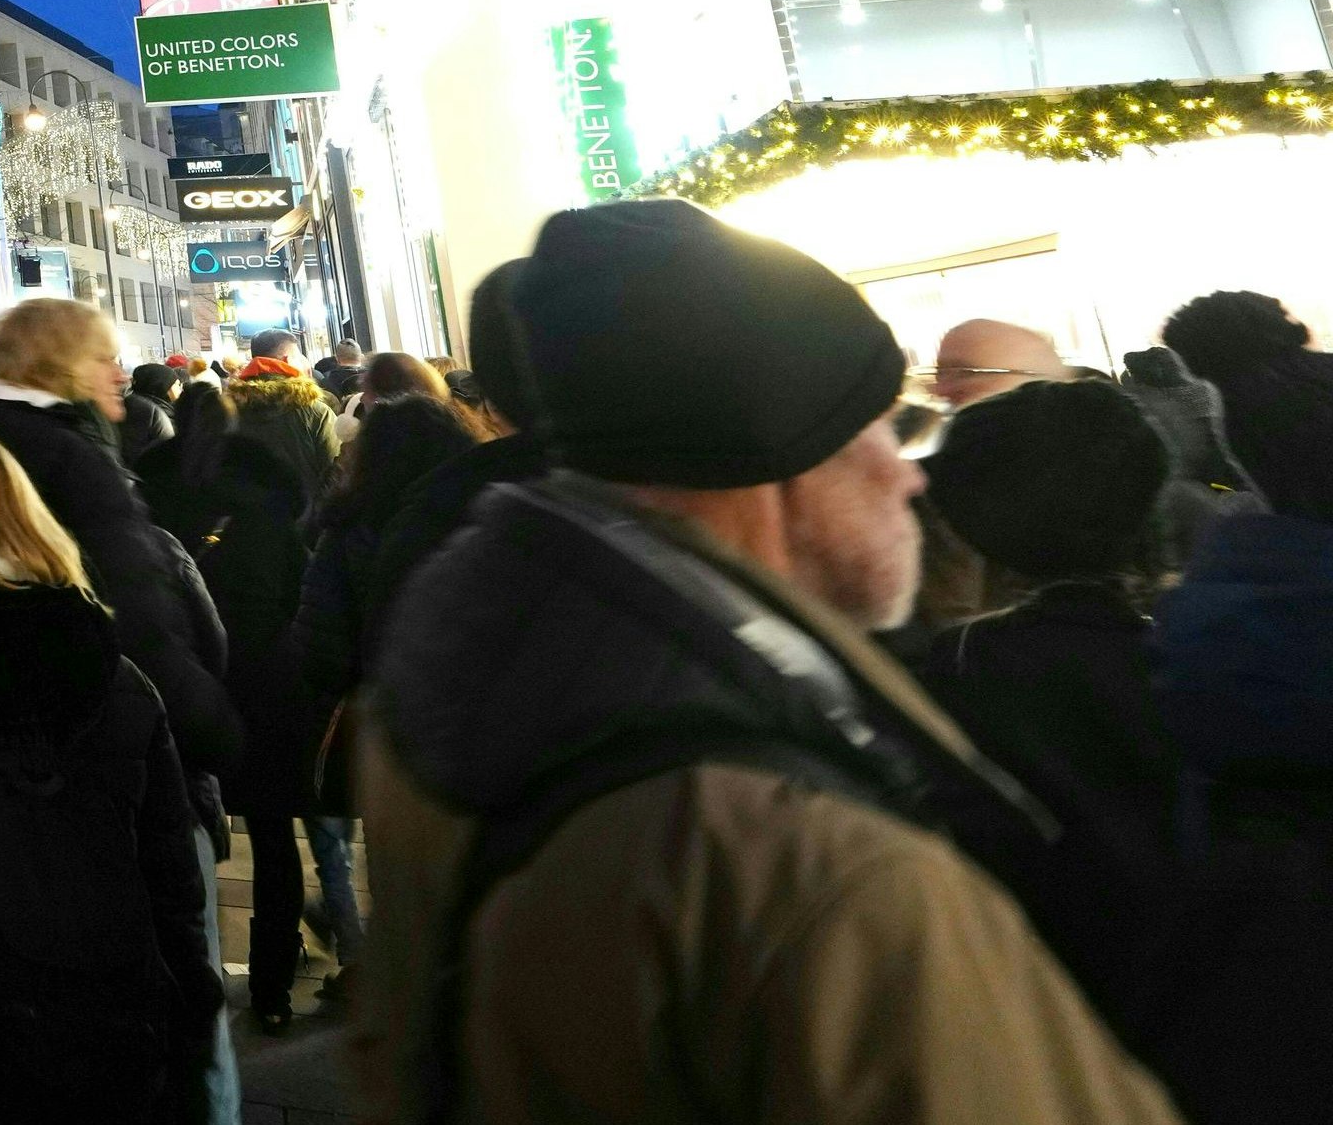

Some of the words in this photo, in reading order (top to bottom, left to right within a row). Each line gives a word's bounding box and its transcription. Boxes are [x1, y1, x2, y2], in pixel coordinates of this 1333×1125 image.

[146, 39, 215, 58] UNITED
[221, 33, 299, 52] COLORS
[148, 61, 173, 76] OF
[178, 54, 285, 74] BENETTON.
[187, 161, 222, 170] RADO
[184, 190, 288, 209] GEOX
[222, 255, 281, 270] IQOS
